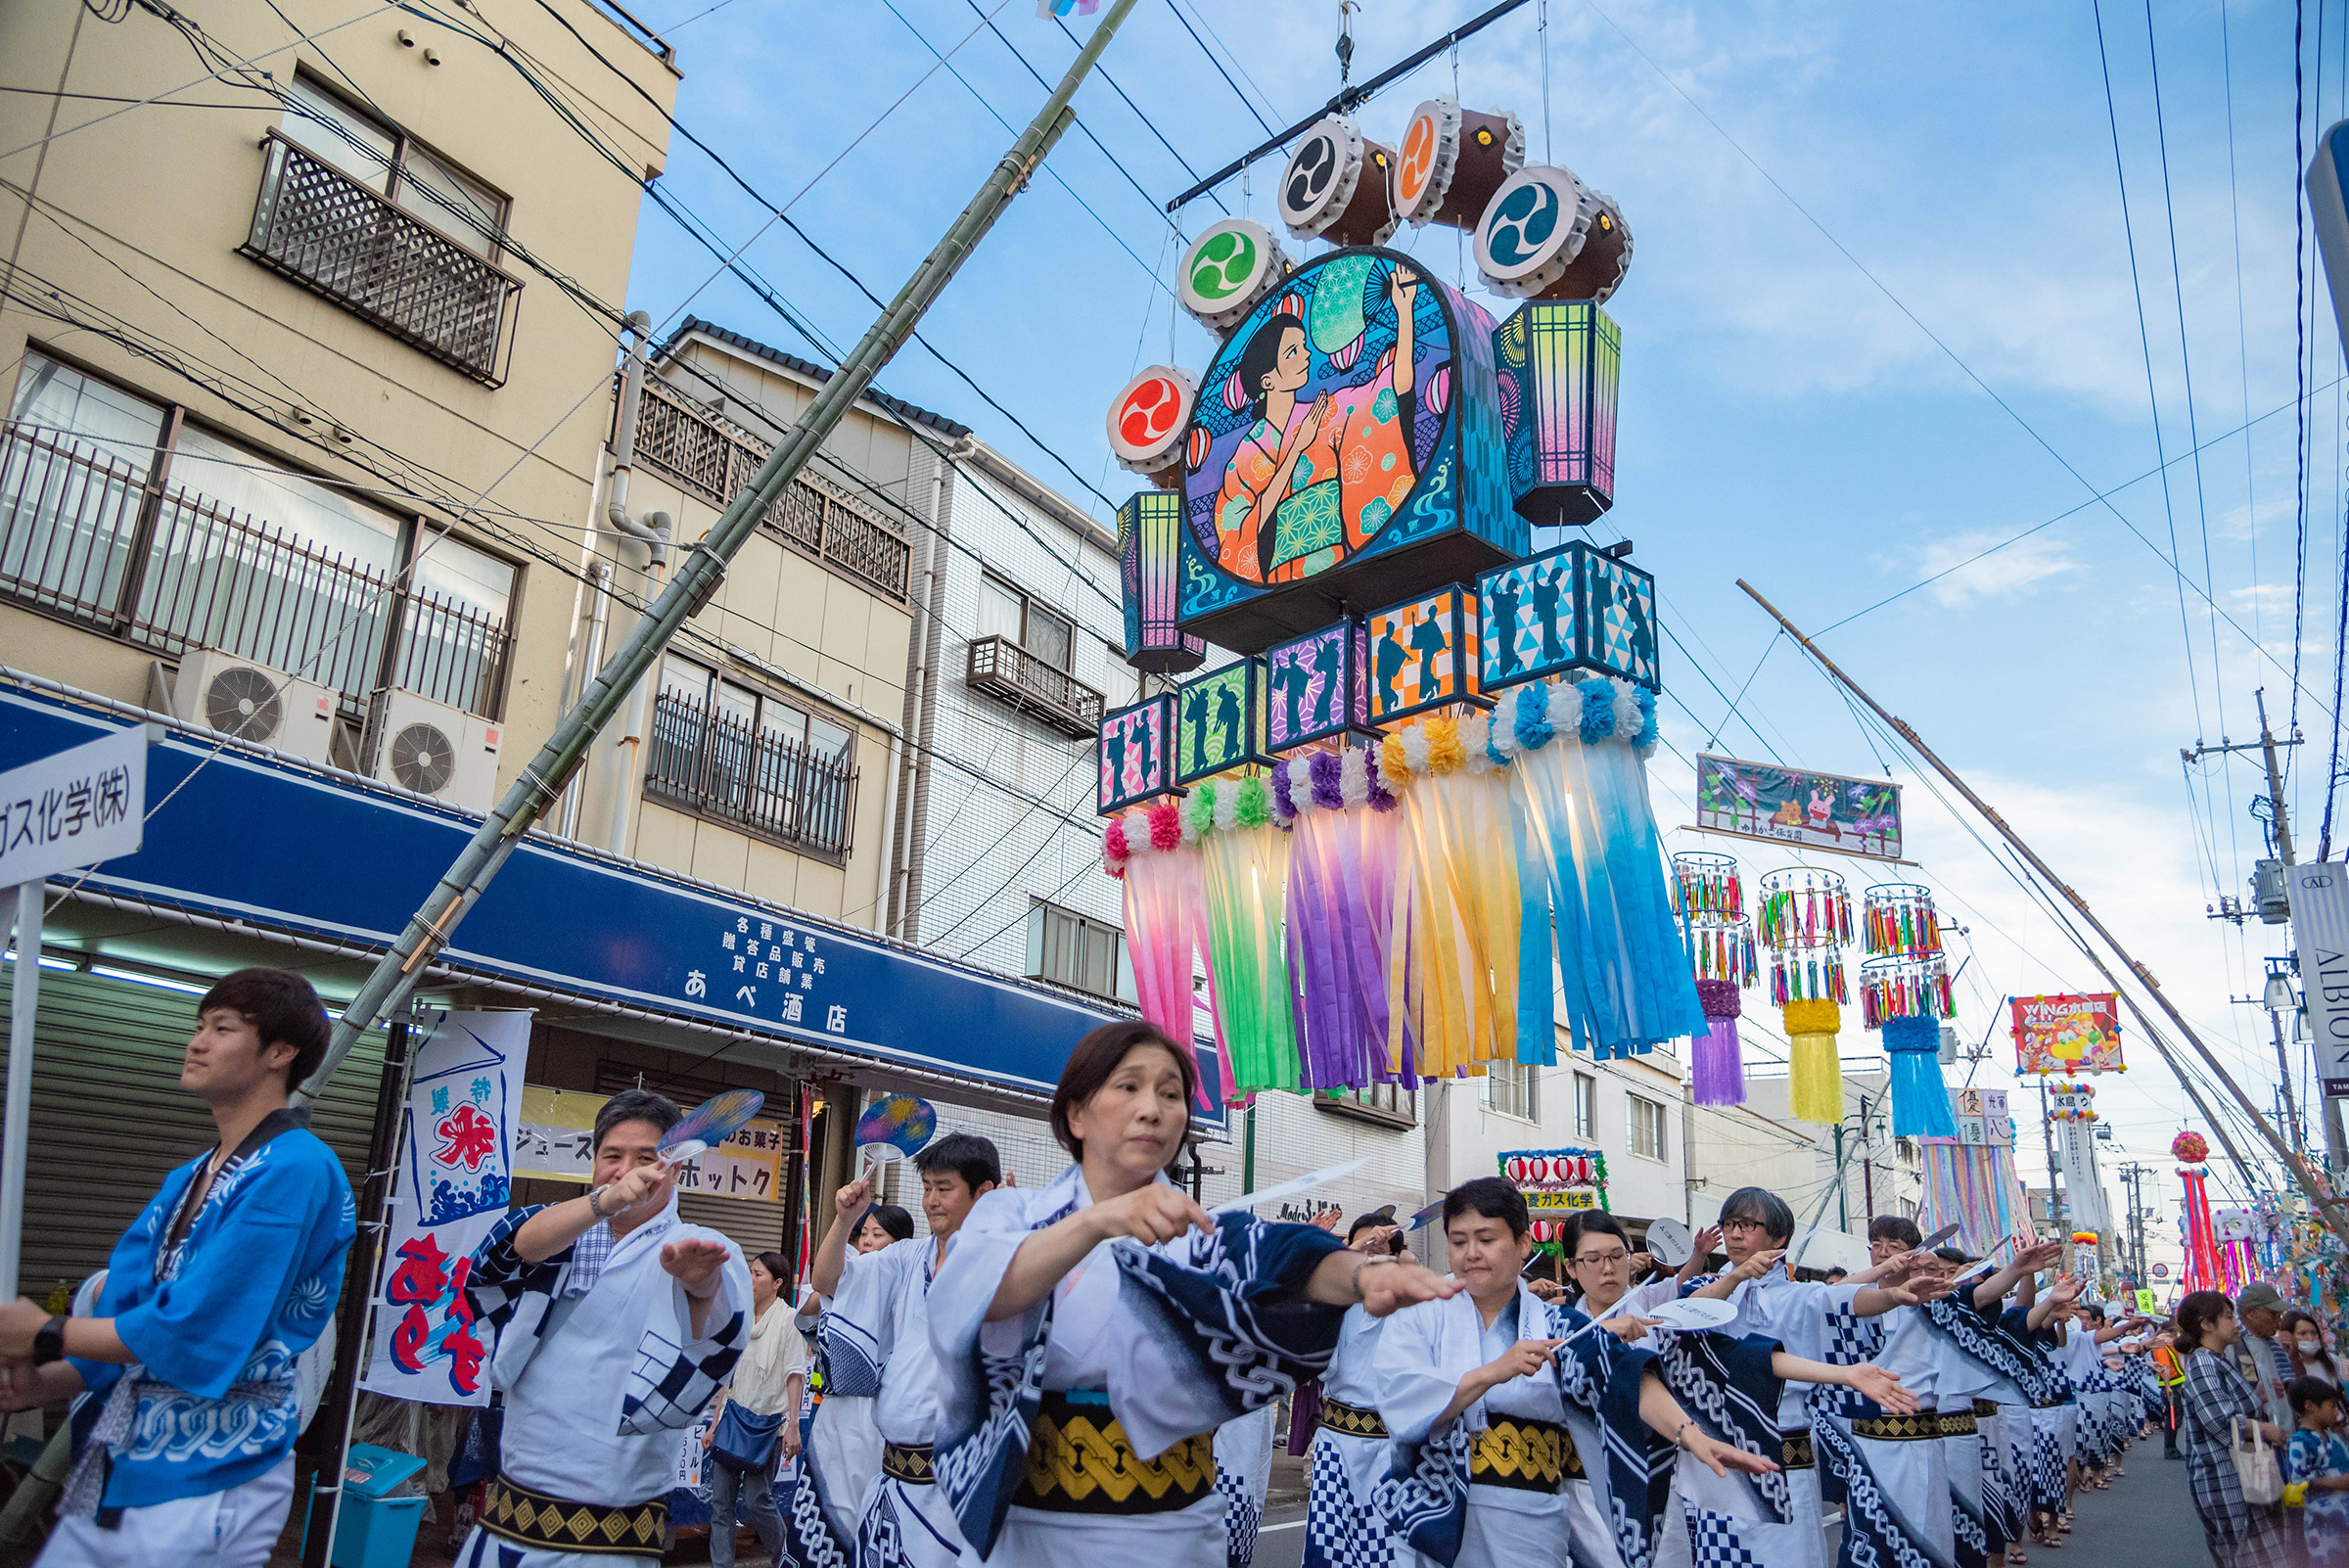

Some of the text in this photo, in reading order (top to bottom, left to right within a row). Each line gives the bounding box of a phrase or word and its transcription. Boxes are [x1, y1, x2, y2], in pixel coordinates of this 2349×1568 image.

[722, 931, 826, 975] 贈答品販売
[732, 954, 814, 991] 貸店舗業
[685, 969, 848, 1034] あべ酒店
[2315, 947, 2349, 1064] ALBION
[1958, 1090, 1981, 1114] 優
[1990, 1119, 2010, 1139] 心
[1524, 1193, 1593, 1208] 菱ガス化学
